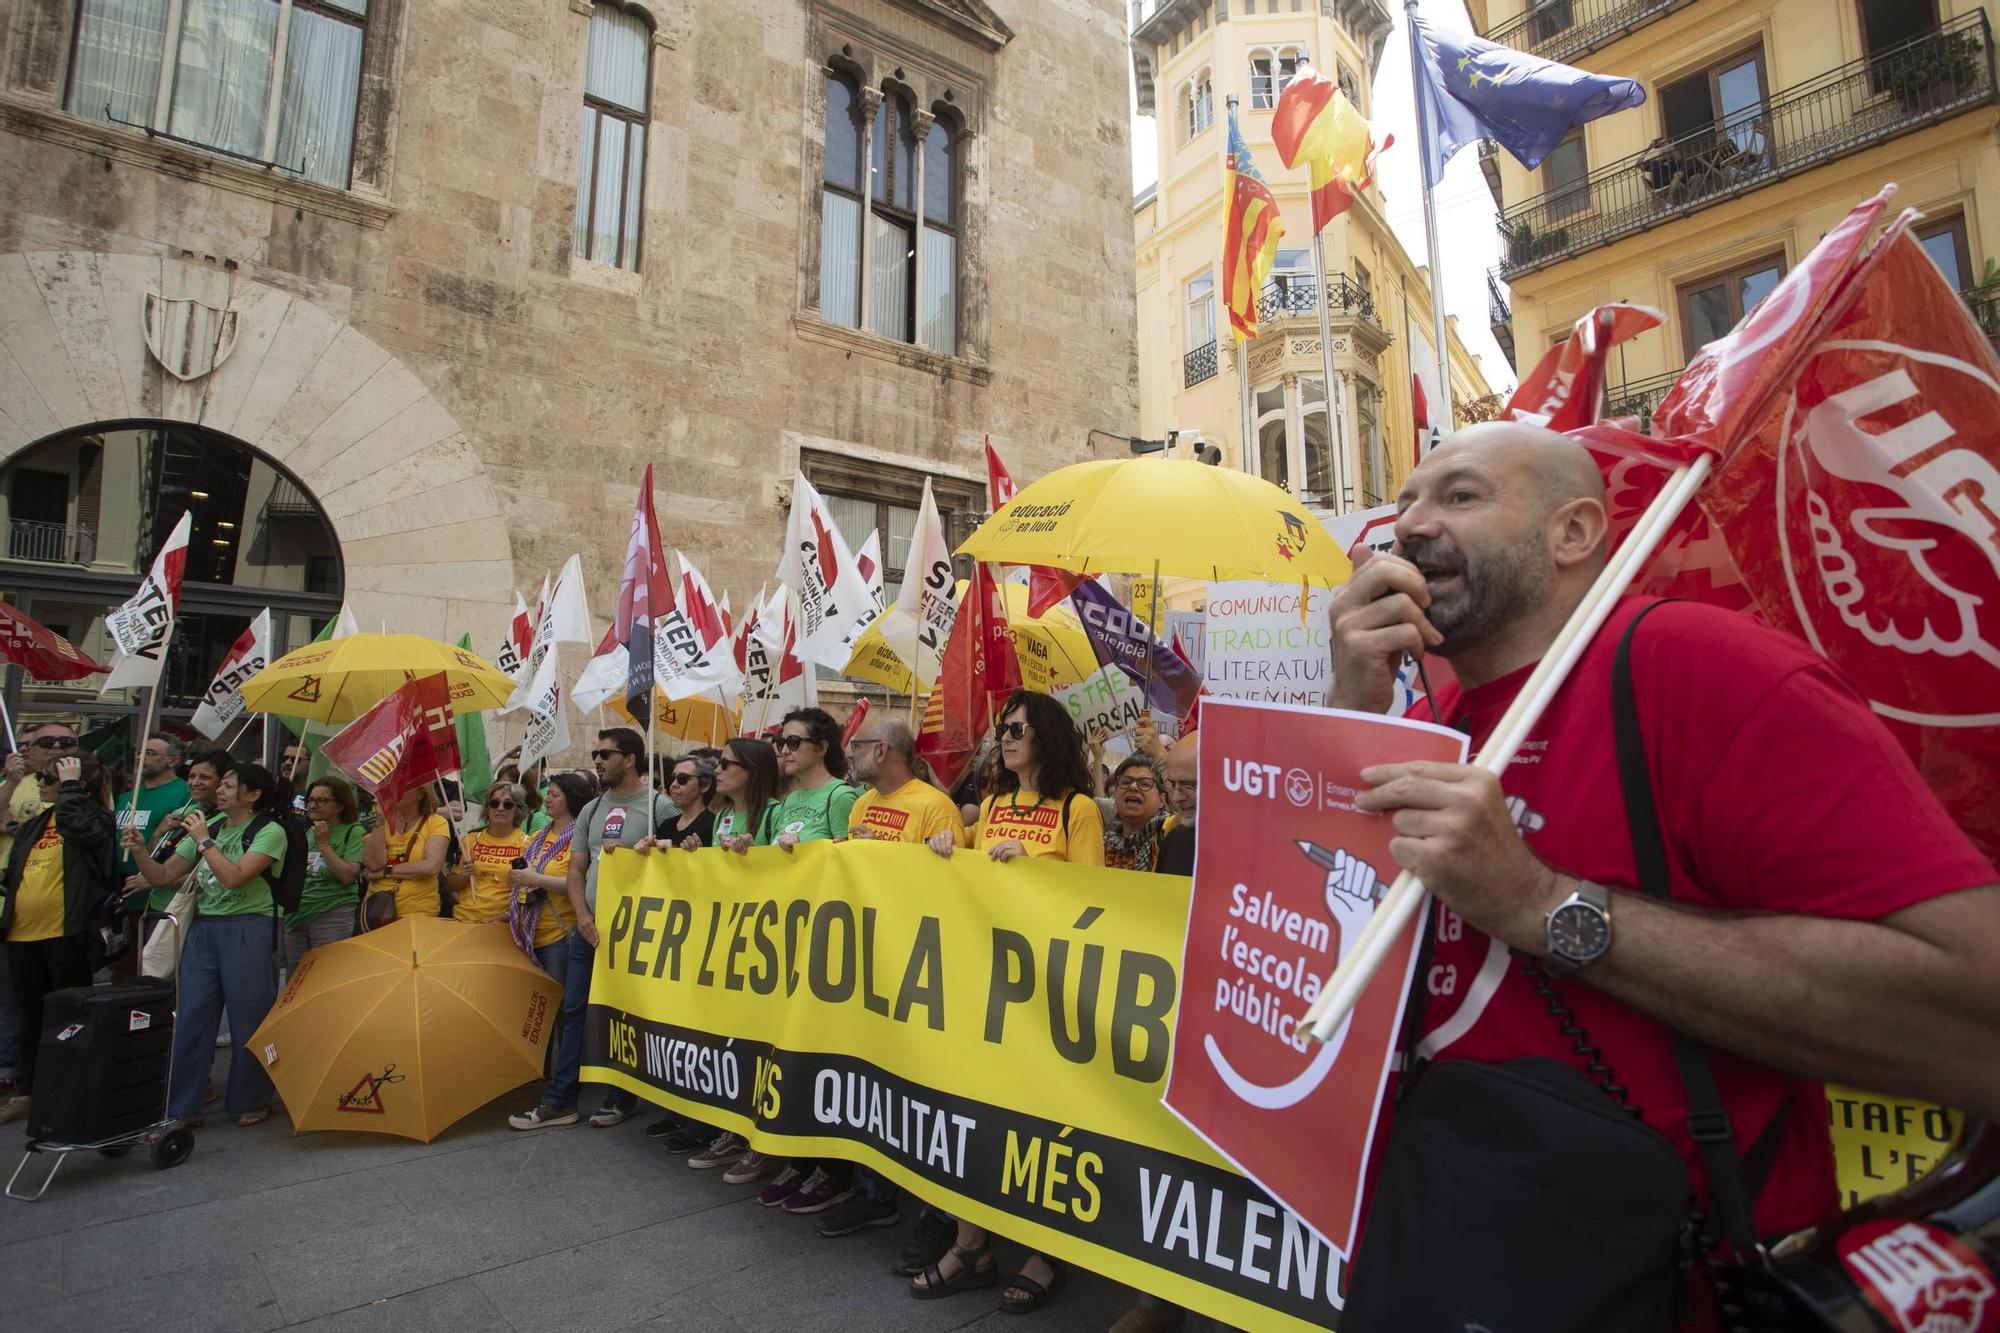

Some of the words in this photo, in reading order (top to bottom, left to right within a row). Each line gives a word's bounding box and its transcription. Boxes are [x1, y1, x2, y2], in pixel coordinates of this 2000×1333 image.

[1010, 499, 1076, 517] educació
[1016, 522, 1030, 532] en
[1134, 583, 1146, 598] 23
[663, 610, 711, 669] TEPV
[1027, 636, 1048, 661] VAGA
[1094, 628, 1147, 659] alencià
[1223, 757, 1281, 800] UGT
[606, 823, 622, 831] CGT
[1229, 883, 1330, 953] Salvem
[1437, 904, 1462, 943] la
[1221, 924, 1322, 1005] l'escola
[1426, 964, 1457, 995] ca
[609, 895, 692, 982] PER
[697, 899, 945, 1032] L'ESCOLA
[983, 906, 1177, 1084] PÚB
[608, 1012, 638, 1069] MÉS
[644, 1037, 739, 1100] INVERSIÓ
[813, 1068, 977, 1179] QUALITAT
[1001, 1126, 1104, 1223] MÉS
